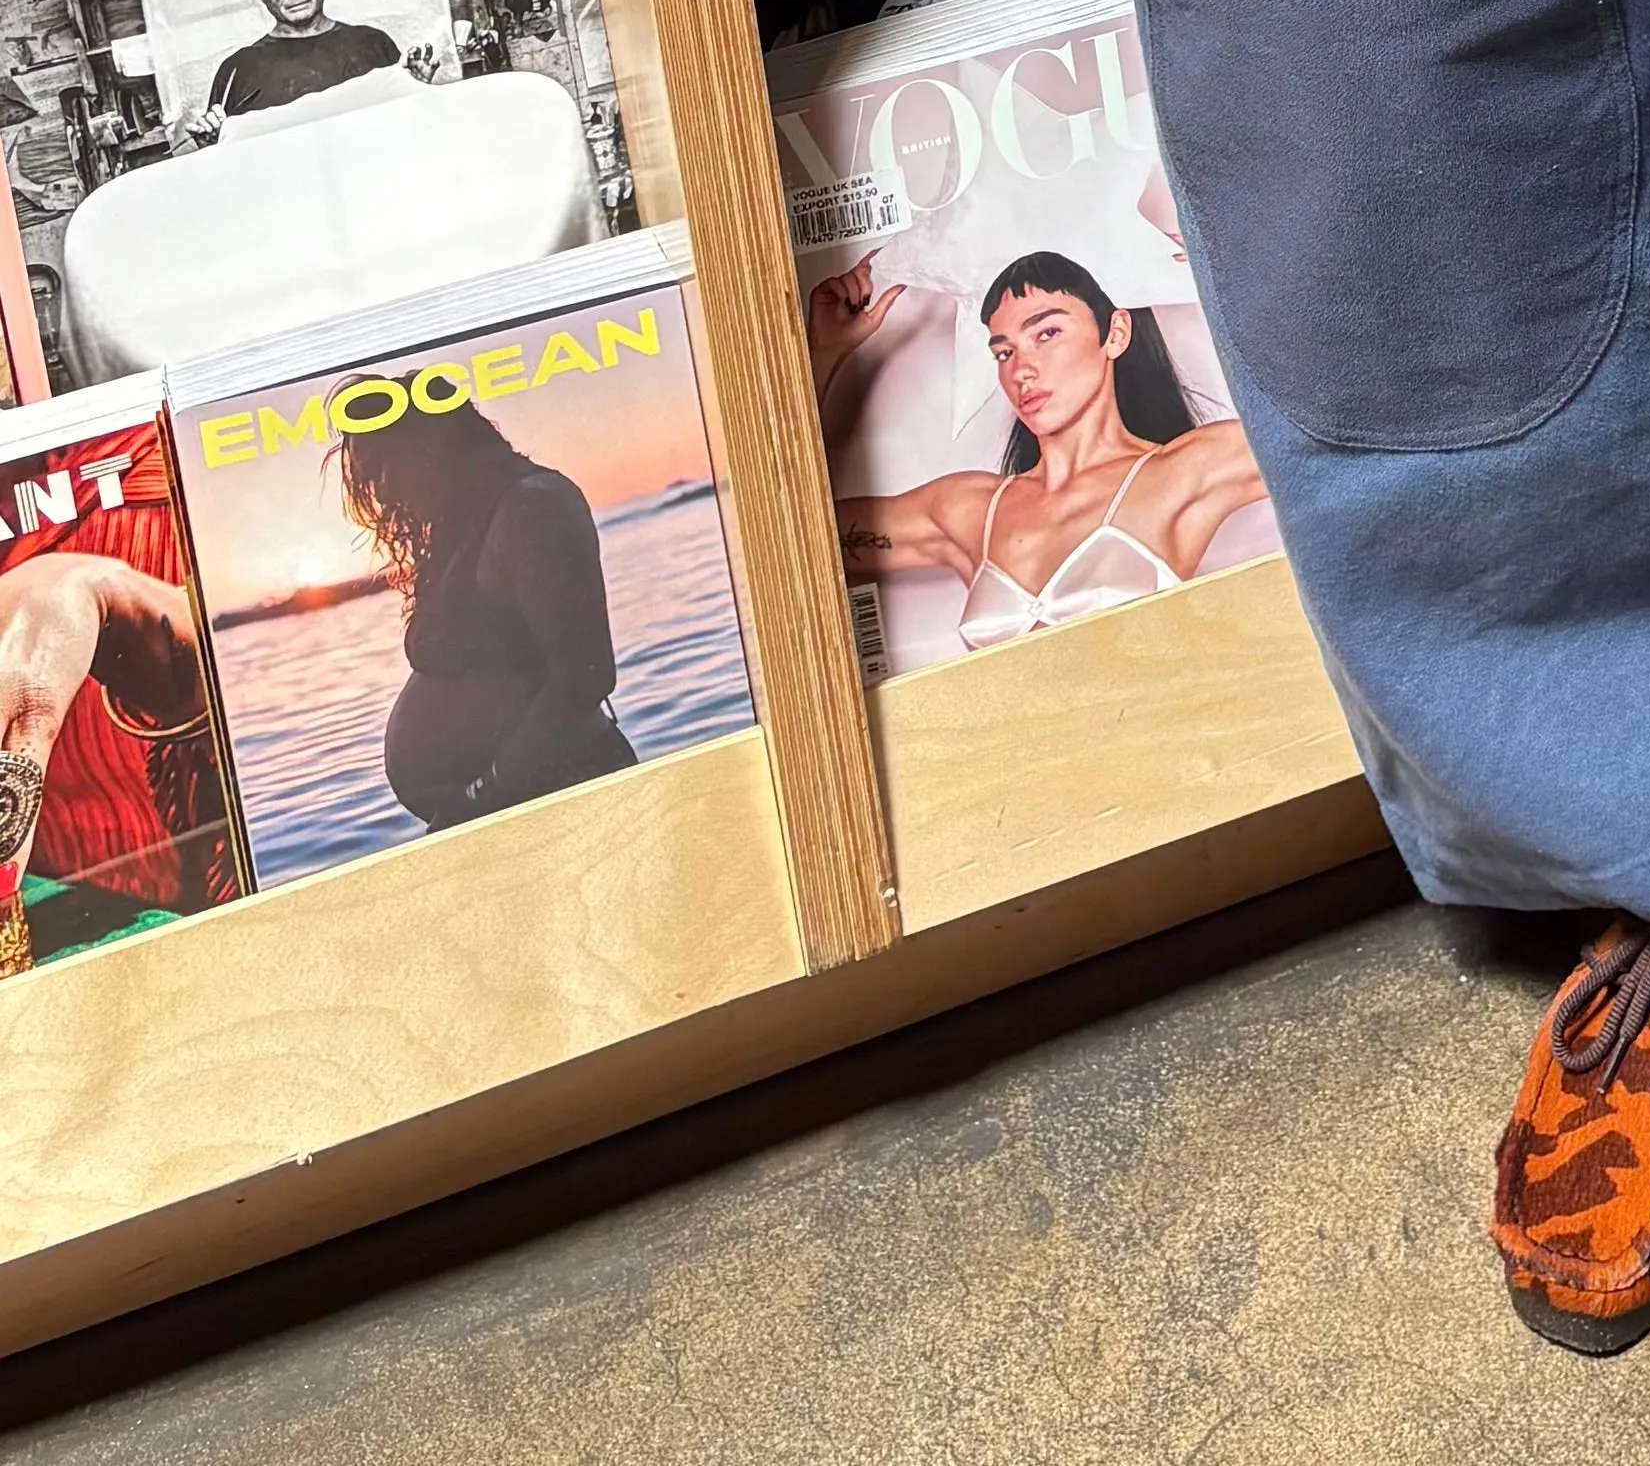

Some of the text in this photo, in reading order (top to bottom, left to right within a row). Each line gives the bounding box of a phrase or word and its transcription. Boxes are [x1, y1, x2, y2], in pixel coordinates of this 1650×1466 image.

[792, 175, 873, 202] VOGUE UK SEA
[792, 194, 840, 215] EXPORT
[199, 306, 661, 470] EMOCEAN
